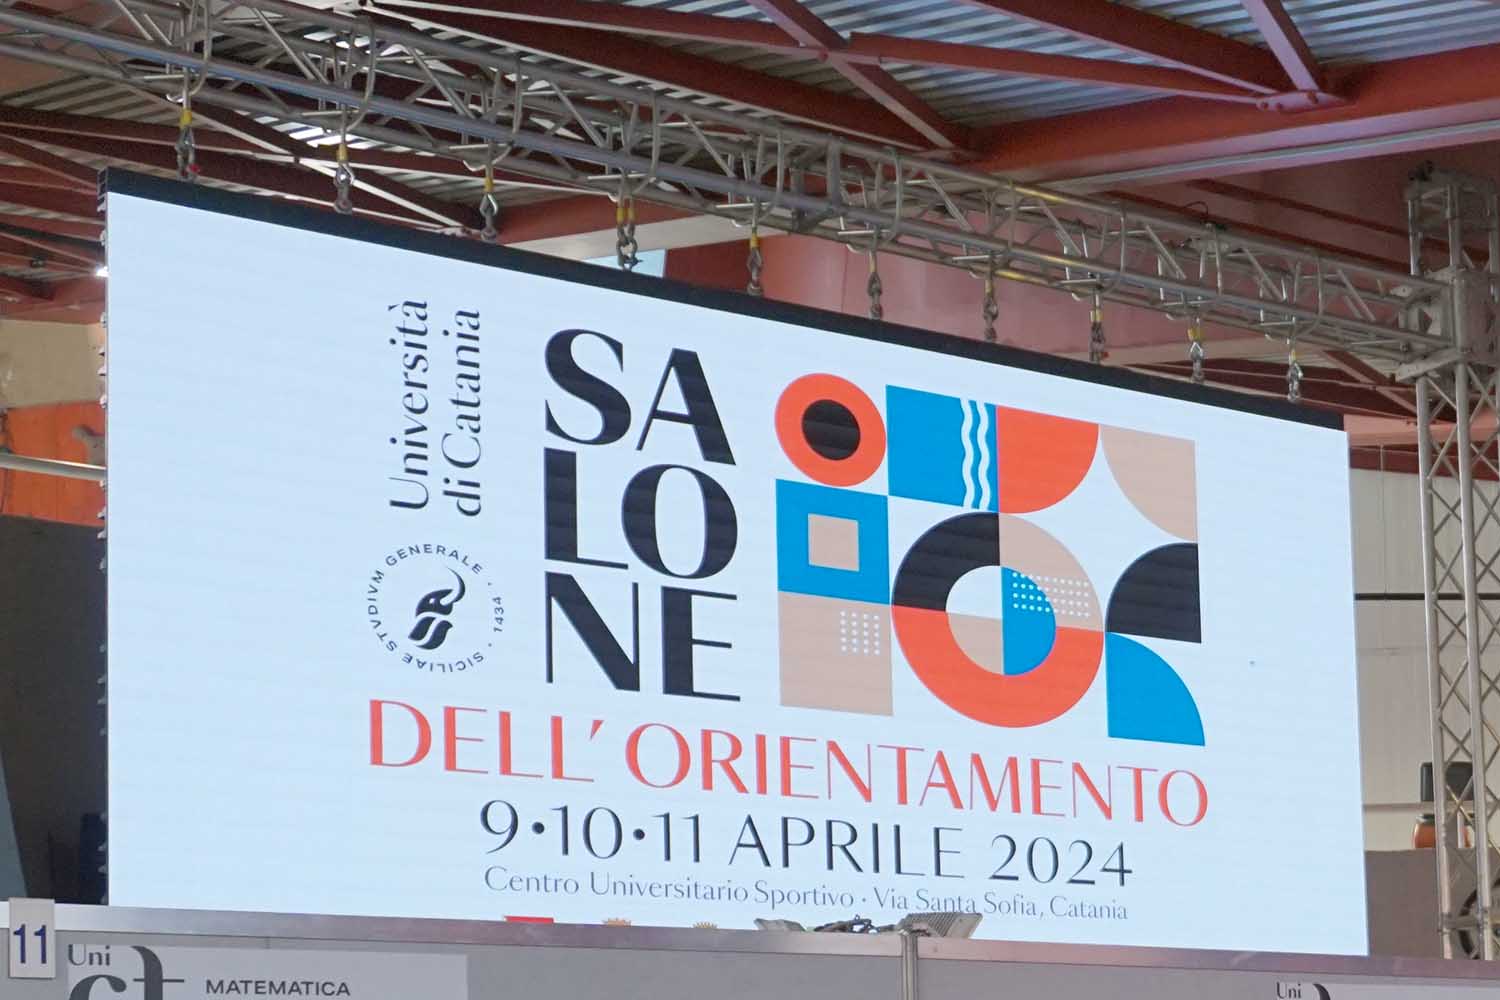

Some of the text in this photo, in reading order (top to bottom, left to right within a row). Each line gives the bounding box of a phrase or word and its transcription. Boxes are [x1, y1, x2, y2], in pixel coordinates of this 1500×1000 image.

[388, 300, 429, 510] Università
[441, 309, 482, 517] di Catania
[544, 328, 737, 466] SA
[544, 447, 739, 580] LO
[367, 543, 505, 673] SICILIAE STVDIVM GENERALE 1434
[545, 571, 741, 703] NE
[484, 865, 1129, 920] Centro Universitario Sportivo Via Santa Sofia, Catania
[729, 814, 965, 879] APRILE
[988, 834, 1133, 886] 2024
[13, 923, 48, 965] 11
[68, 943, 111, 967] Uni
[205, 979, 350, 997] MATEMATICA
[1276, 982, 1302, 999] Uni
